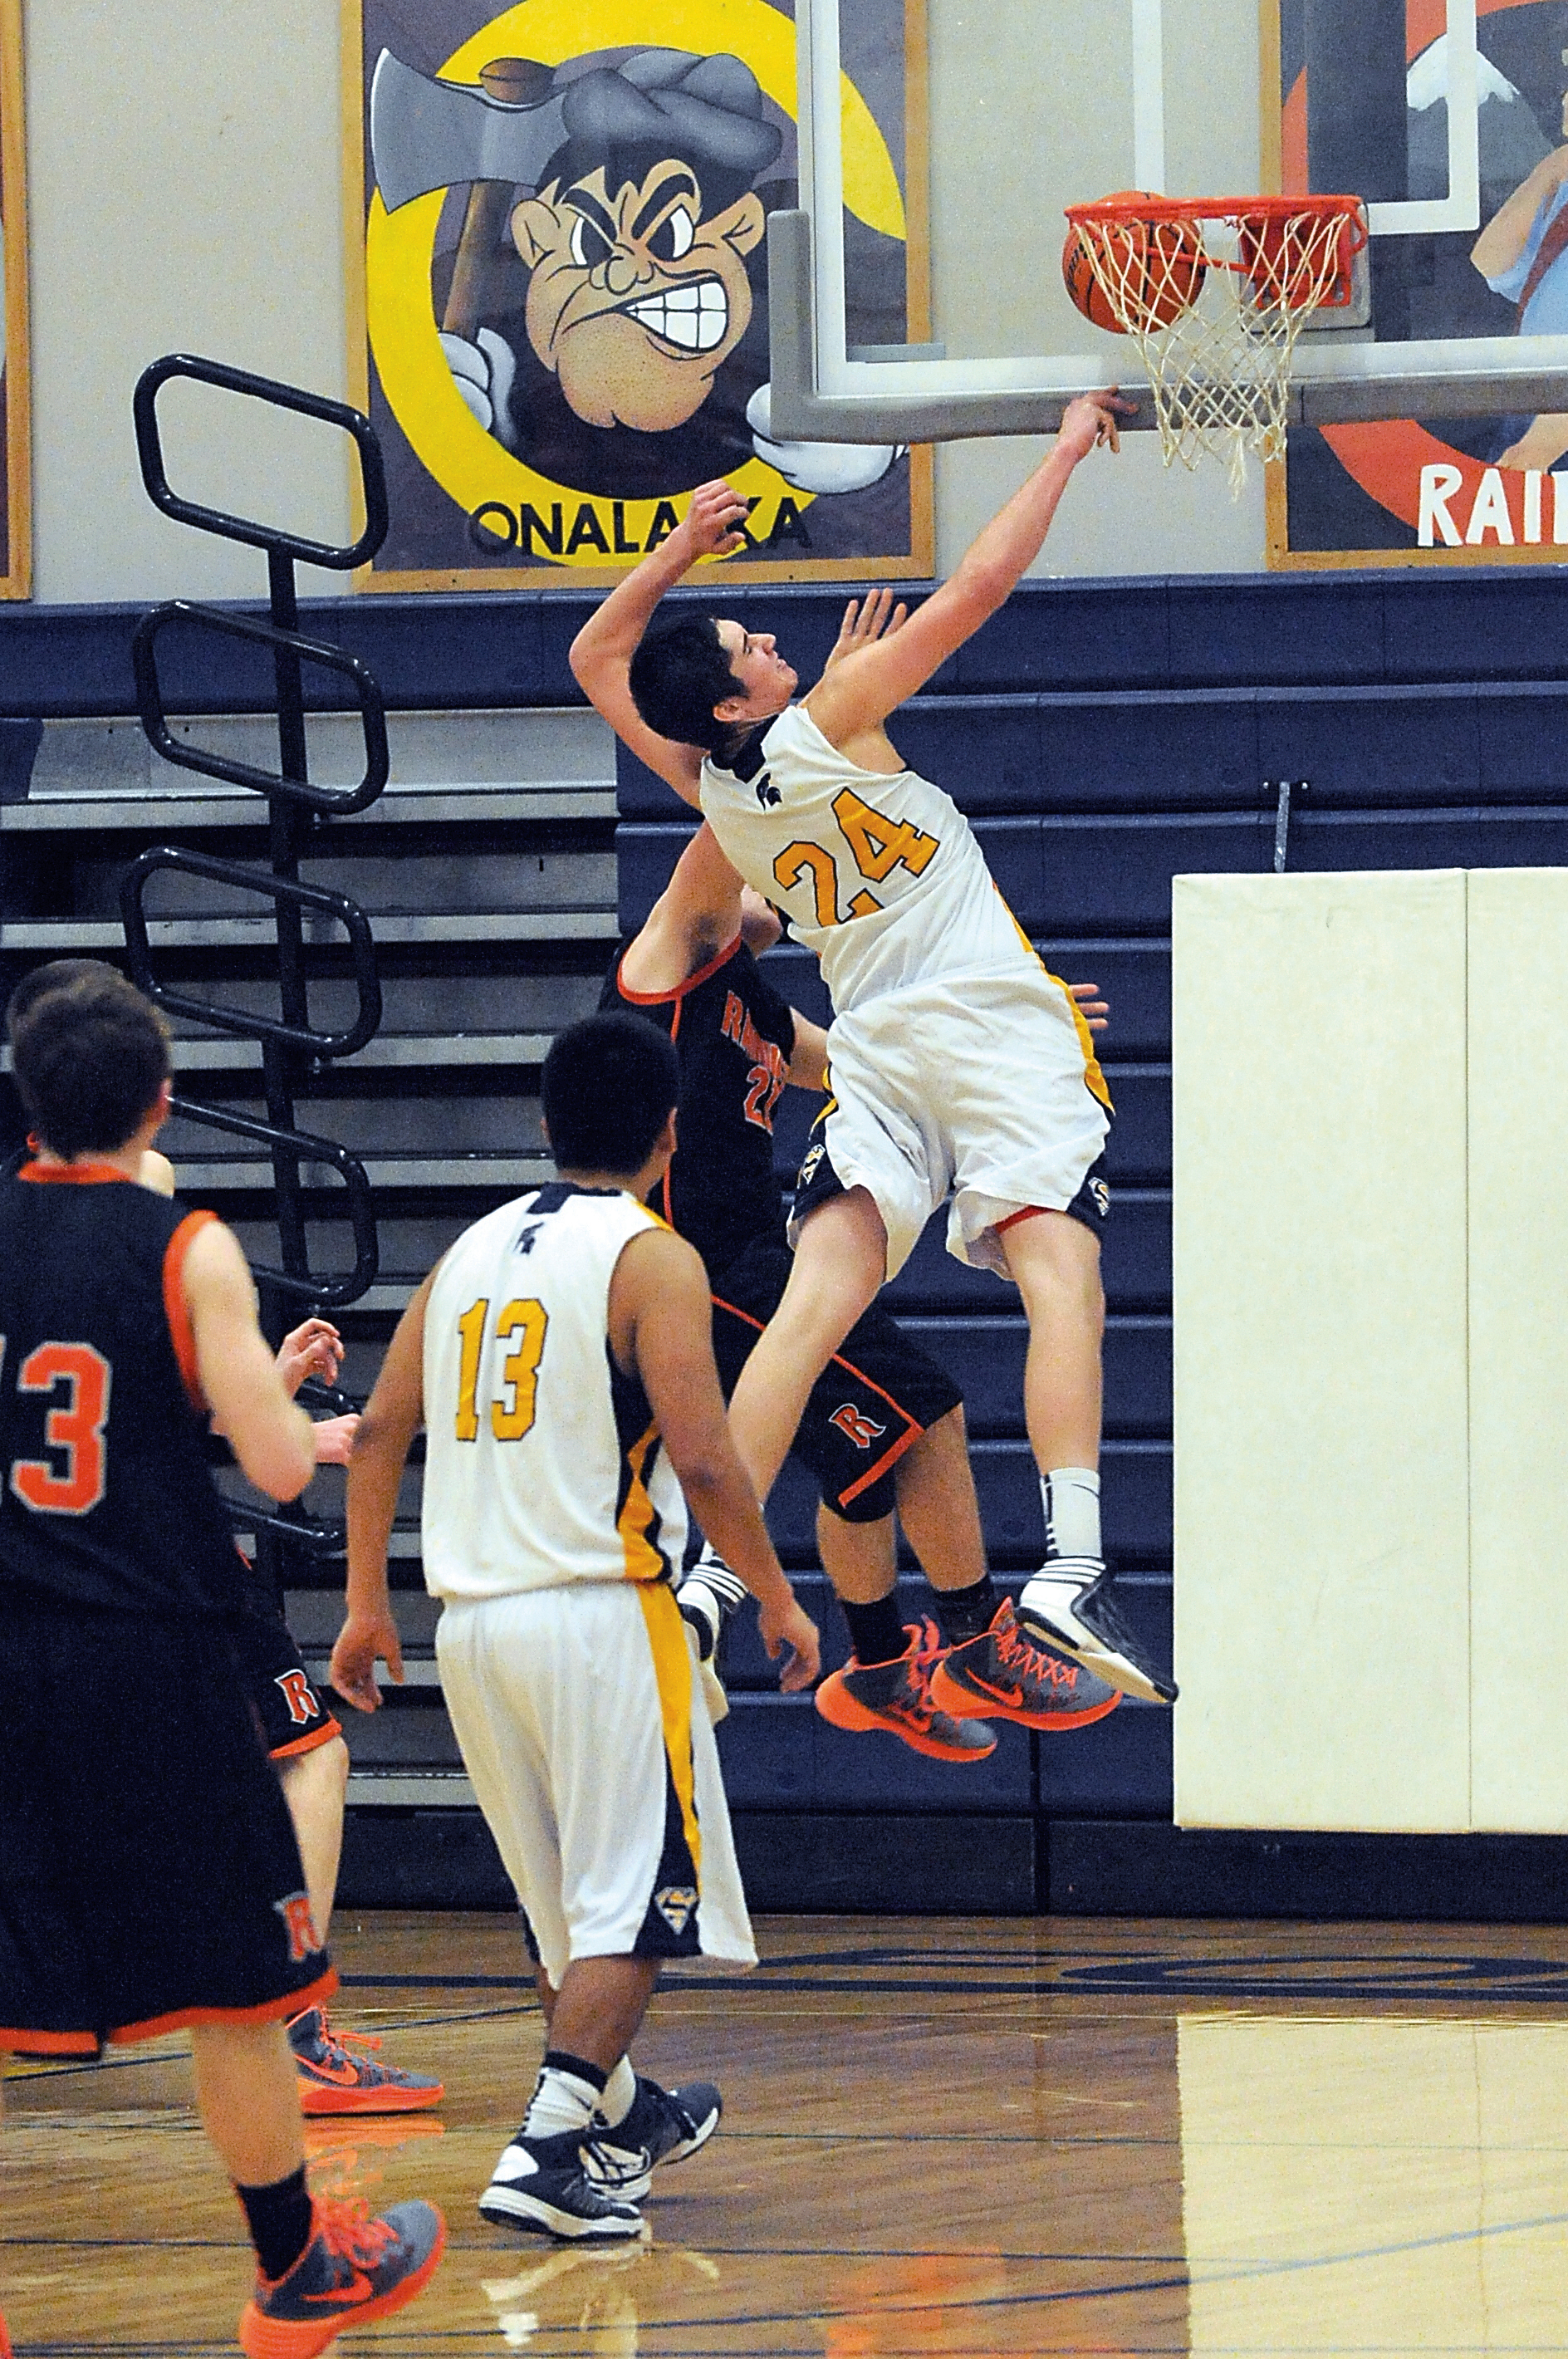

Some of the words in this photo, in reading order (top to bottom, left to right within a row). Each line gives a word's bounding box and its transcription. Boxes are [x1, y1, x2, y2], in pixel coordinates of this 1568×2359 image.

[468, 496, 814, 556] ONALAKA
[772, 787, 940, 928] 24
[455, 1297, 549, 1442] 13
[0, 1334, 111, 1515] 3
[829, 1403, 886, 1449] R
[274, 1669, 320, 1724] R
[272, 1891, 323, 1962] R
